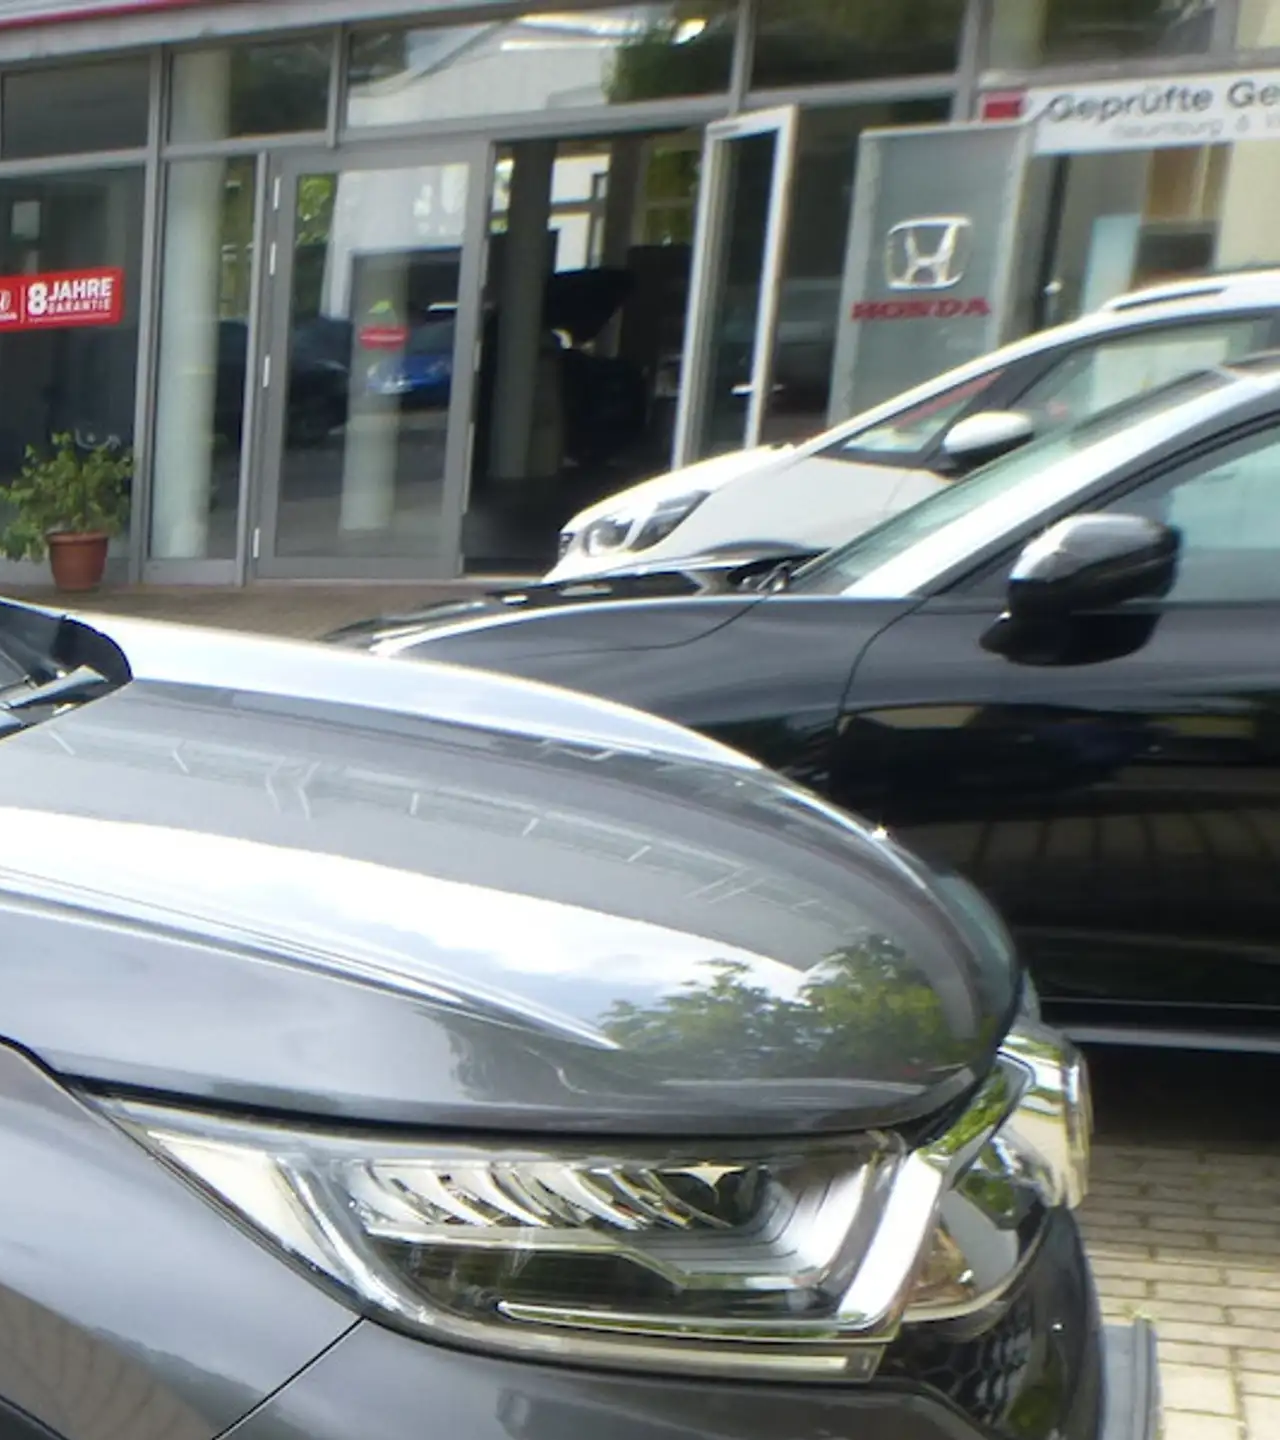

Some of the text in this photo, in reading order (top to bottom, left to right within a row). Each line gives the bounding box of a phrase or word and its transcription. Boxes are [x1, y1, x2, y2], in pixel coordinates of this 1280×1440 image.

[1044, 84, 1214, 124] Geprüfte
[28, 276, 114, 315] 8 JAHRE
[48, 298, 111, 315] GARANTIE
[851, 297, 990, 320] HONDA
